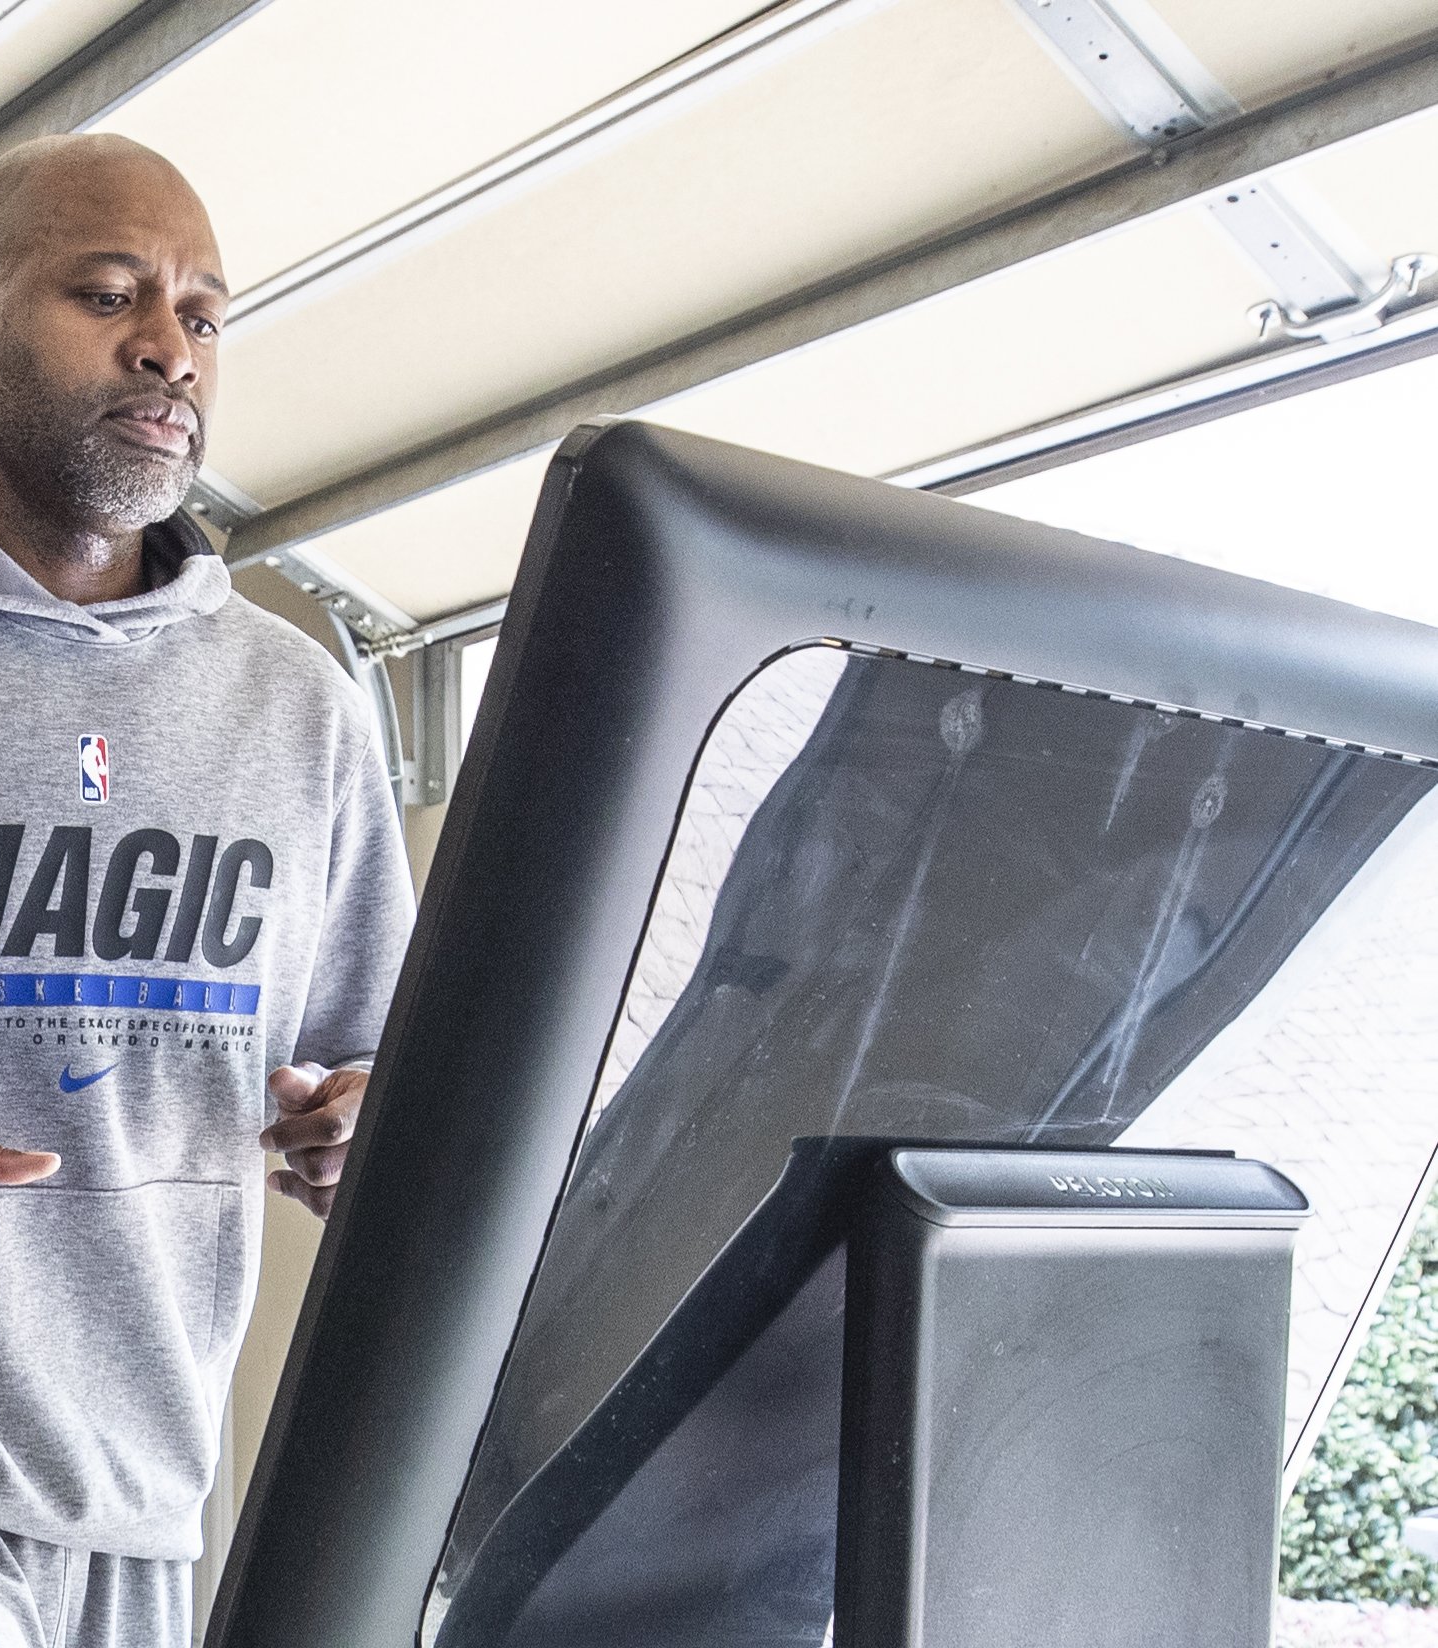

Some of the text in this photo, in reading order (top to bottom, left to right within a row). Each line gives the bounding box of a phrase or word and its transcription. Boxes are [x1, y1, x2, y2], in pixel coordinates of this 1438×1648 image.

[4, 1017, 26, 1029] TO
[36, 1017, 68, 1029] THE
[78, 1017, 122, 1030] EXACT
[128, 1018, 254, 1036] SPECIFICATIONS
[33, 1033, 159, 1048] ORLANDO
[184, 1038, 252, 1052] MAGIC
